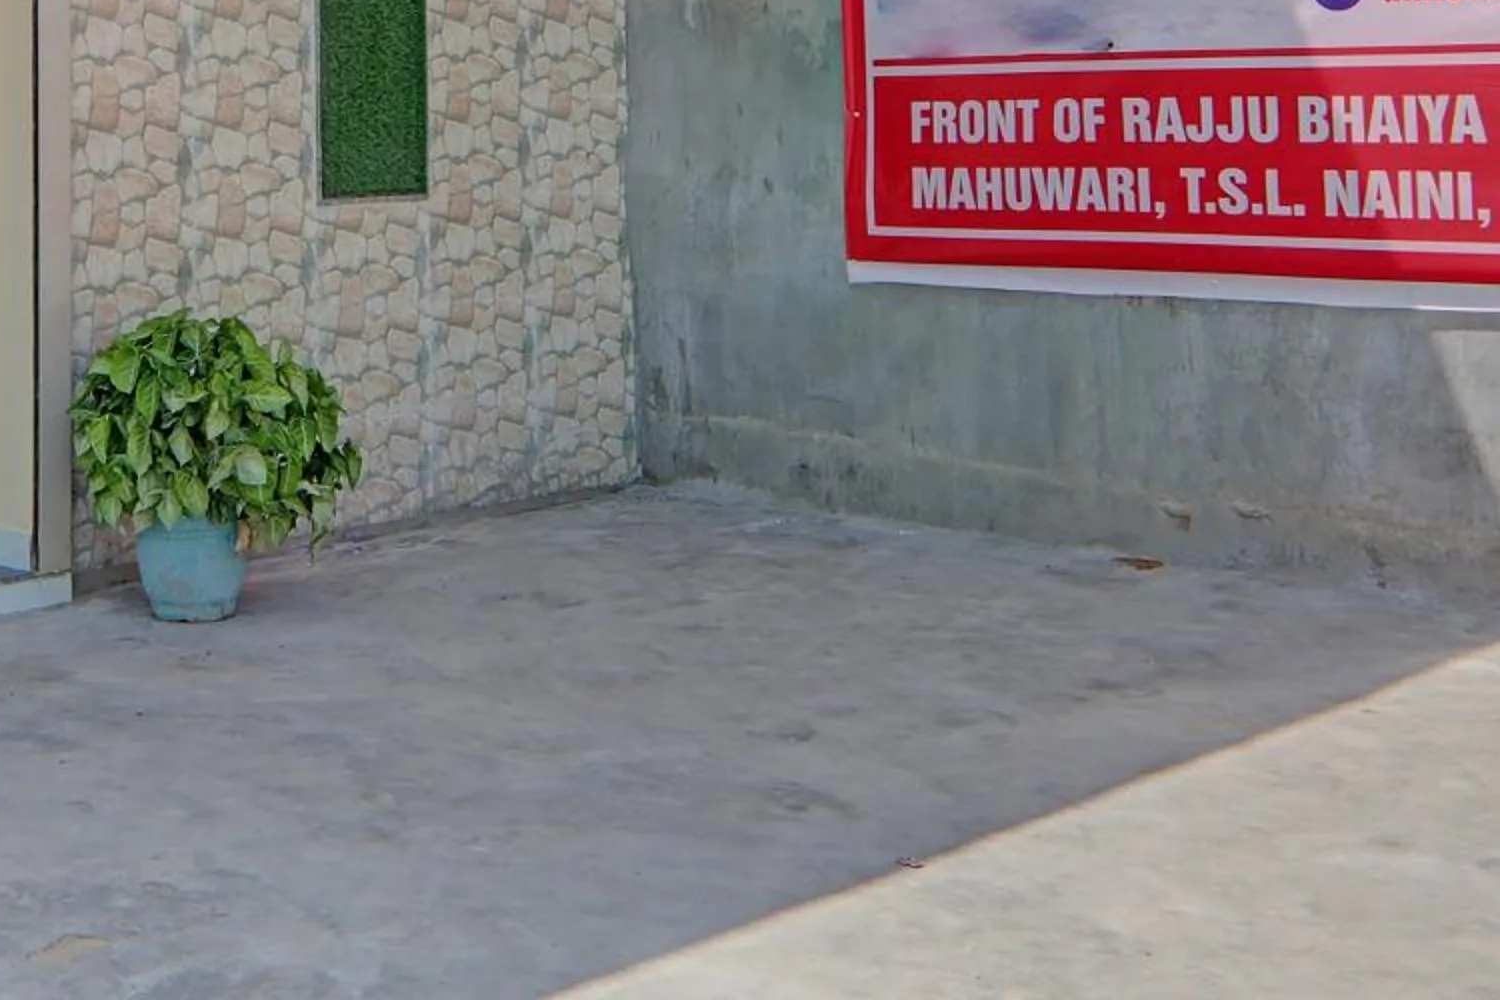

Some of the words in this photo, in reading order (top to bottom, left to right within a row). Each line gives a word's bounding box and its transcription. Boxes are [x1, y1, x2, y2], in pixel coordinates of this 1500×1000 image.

[910, 99, 1040, 144] FRONT
[1053, 97, 1105, 144] OF
[1122, 95, 1279, 144] RAJJU
[1297, 94, 1487, 145] BHAIYA
[910, 167, 1165, 218] MAHUWARI,
[1179, 168, 1305, 216] T.S.L.
[1322, 169, 1492, 228] NAINI,
